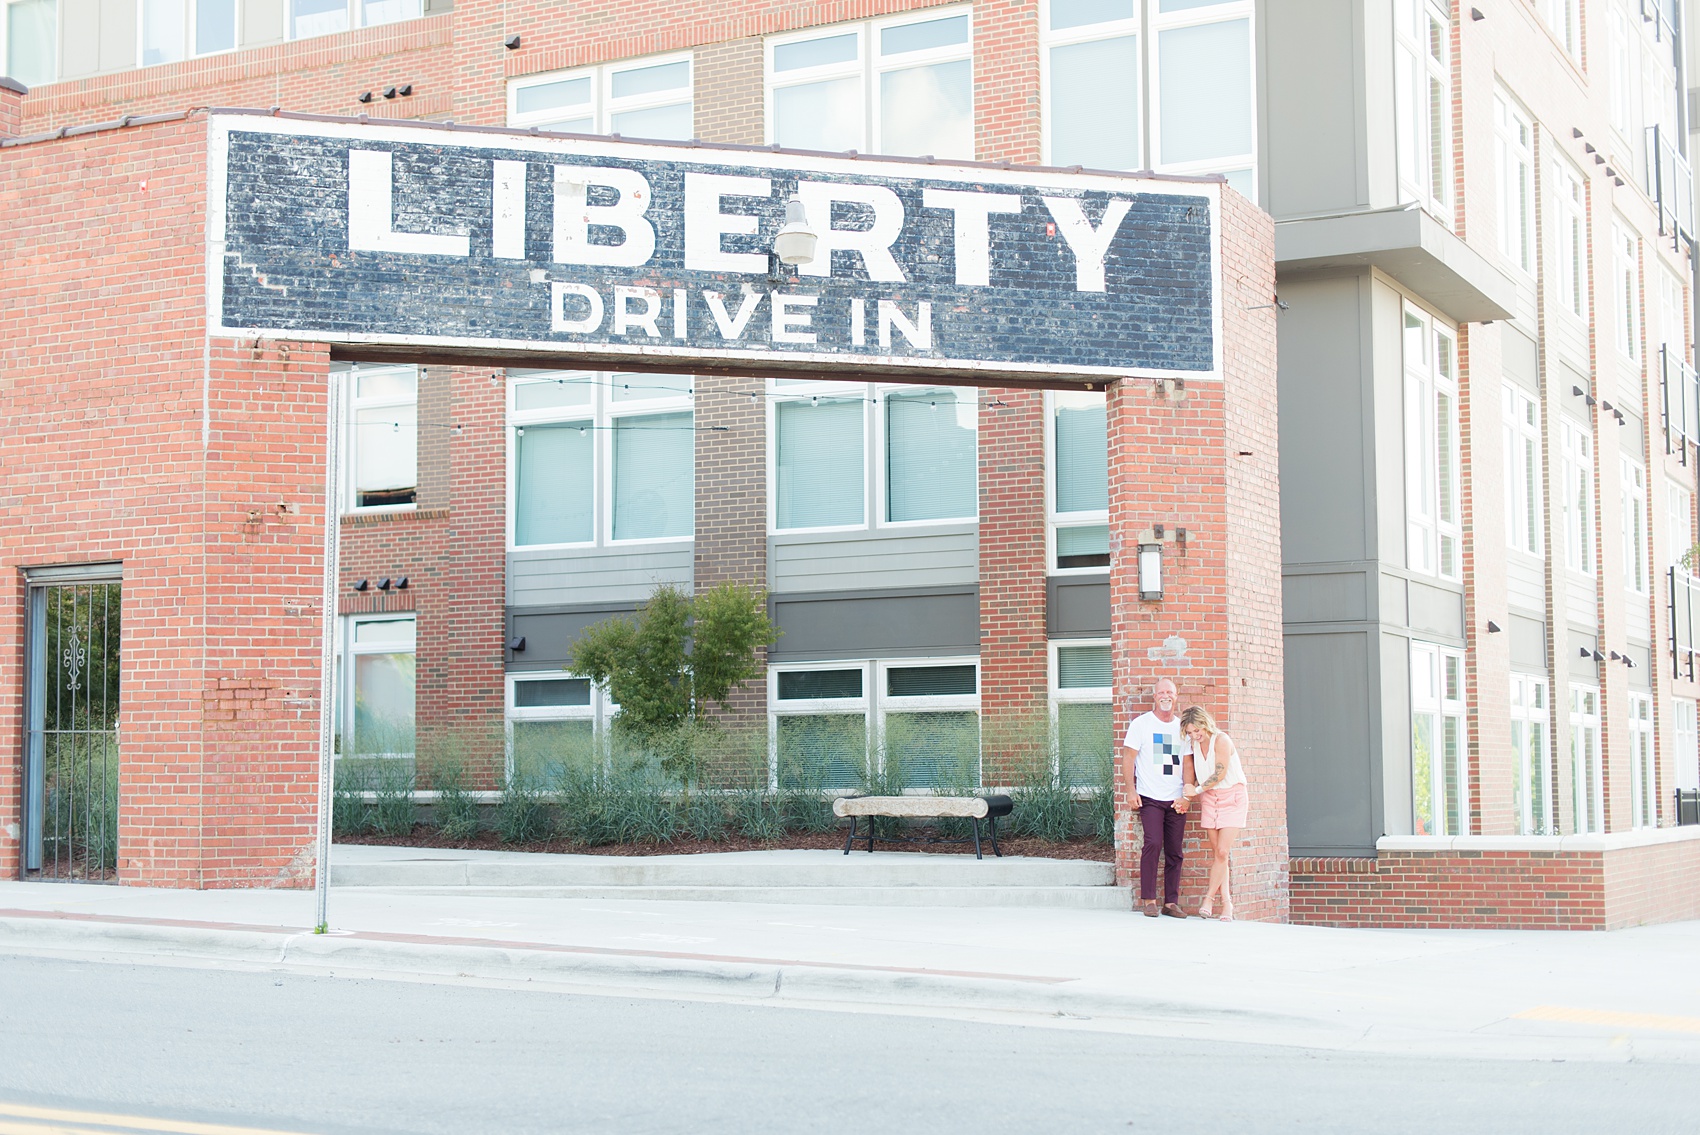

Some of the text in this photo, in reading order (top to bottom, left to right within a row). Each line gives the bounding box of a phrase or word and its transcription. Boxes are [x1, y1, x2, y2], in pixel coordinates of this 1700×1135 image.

[348, 149, 1133, 292] LIBERTY
[551, 281, 932, 349] DRIVE IN
